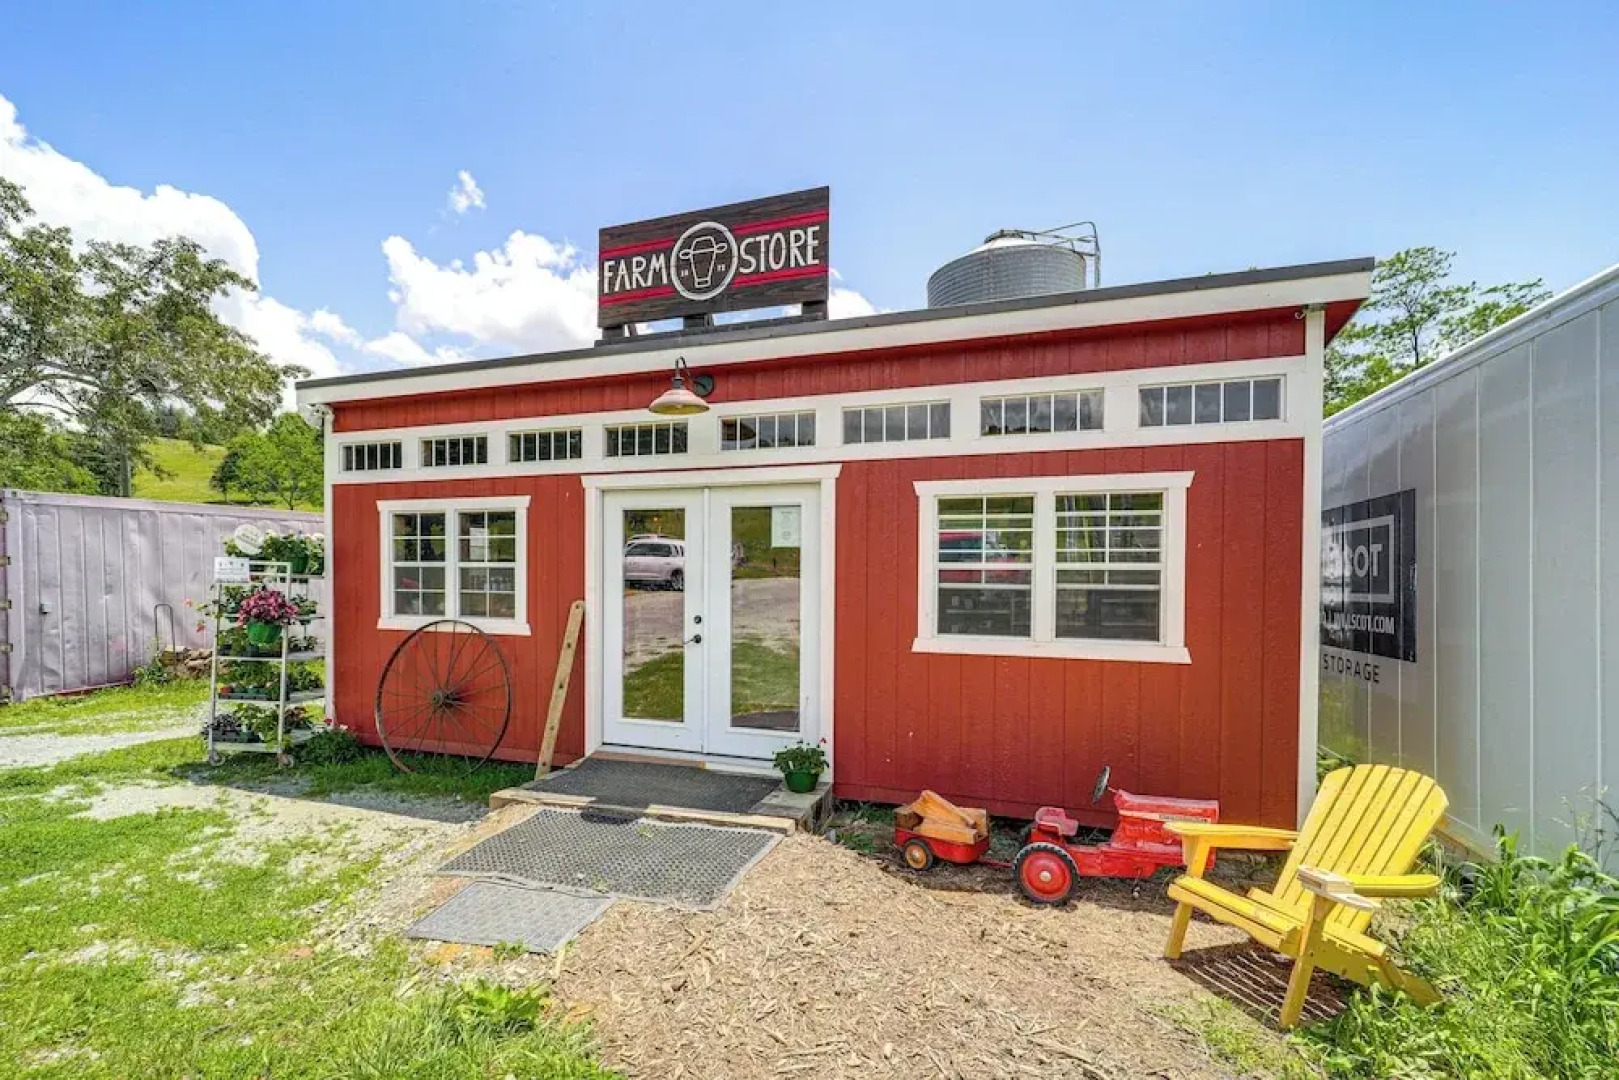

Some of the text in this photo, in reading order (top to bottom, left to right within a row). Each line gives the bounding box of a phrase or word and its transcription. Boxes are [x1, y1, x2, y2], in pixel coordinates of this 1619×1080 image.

[603, 226, 820, 294] FARM STORE
[1322, 653, 1381, 684] STORAGE
